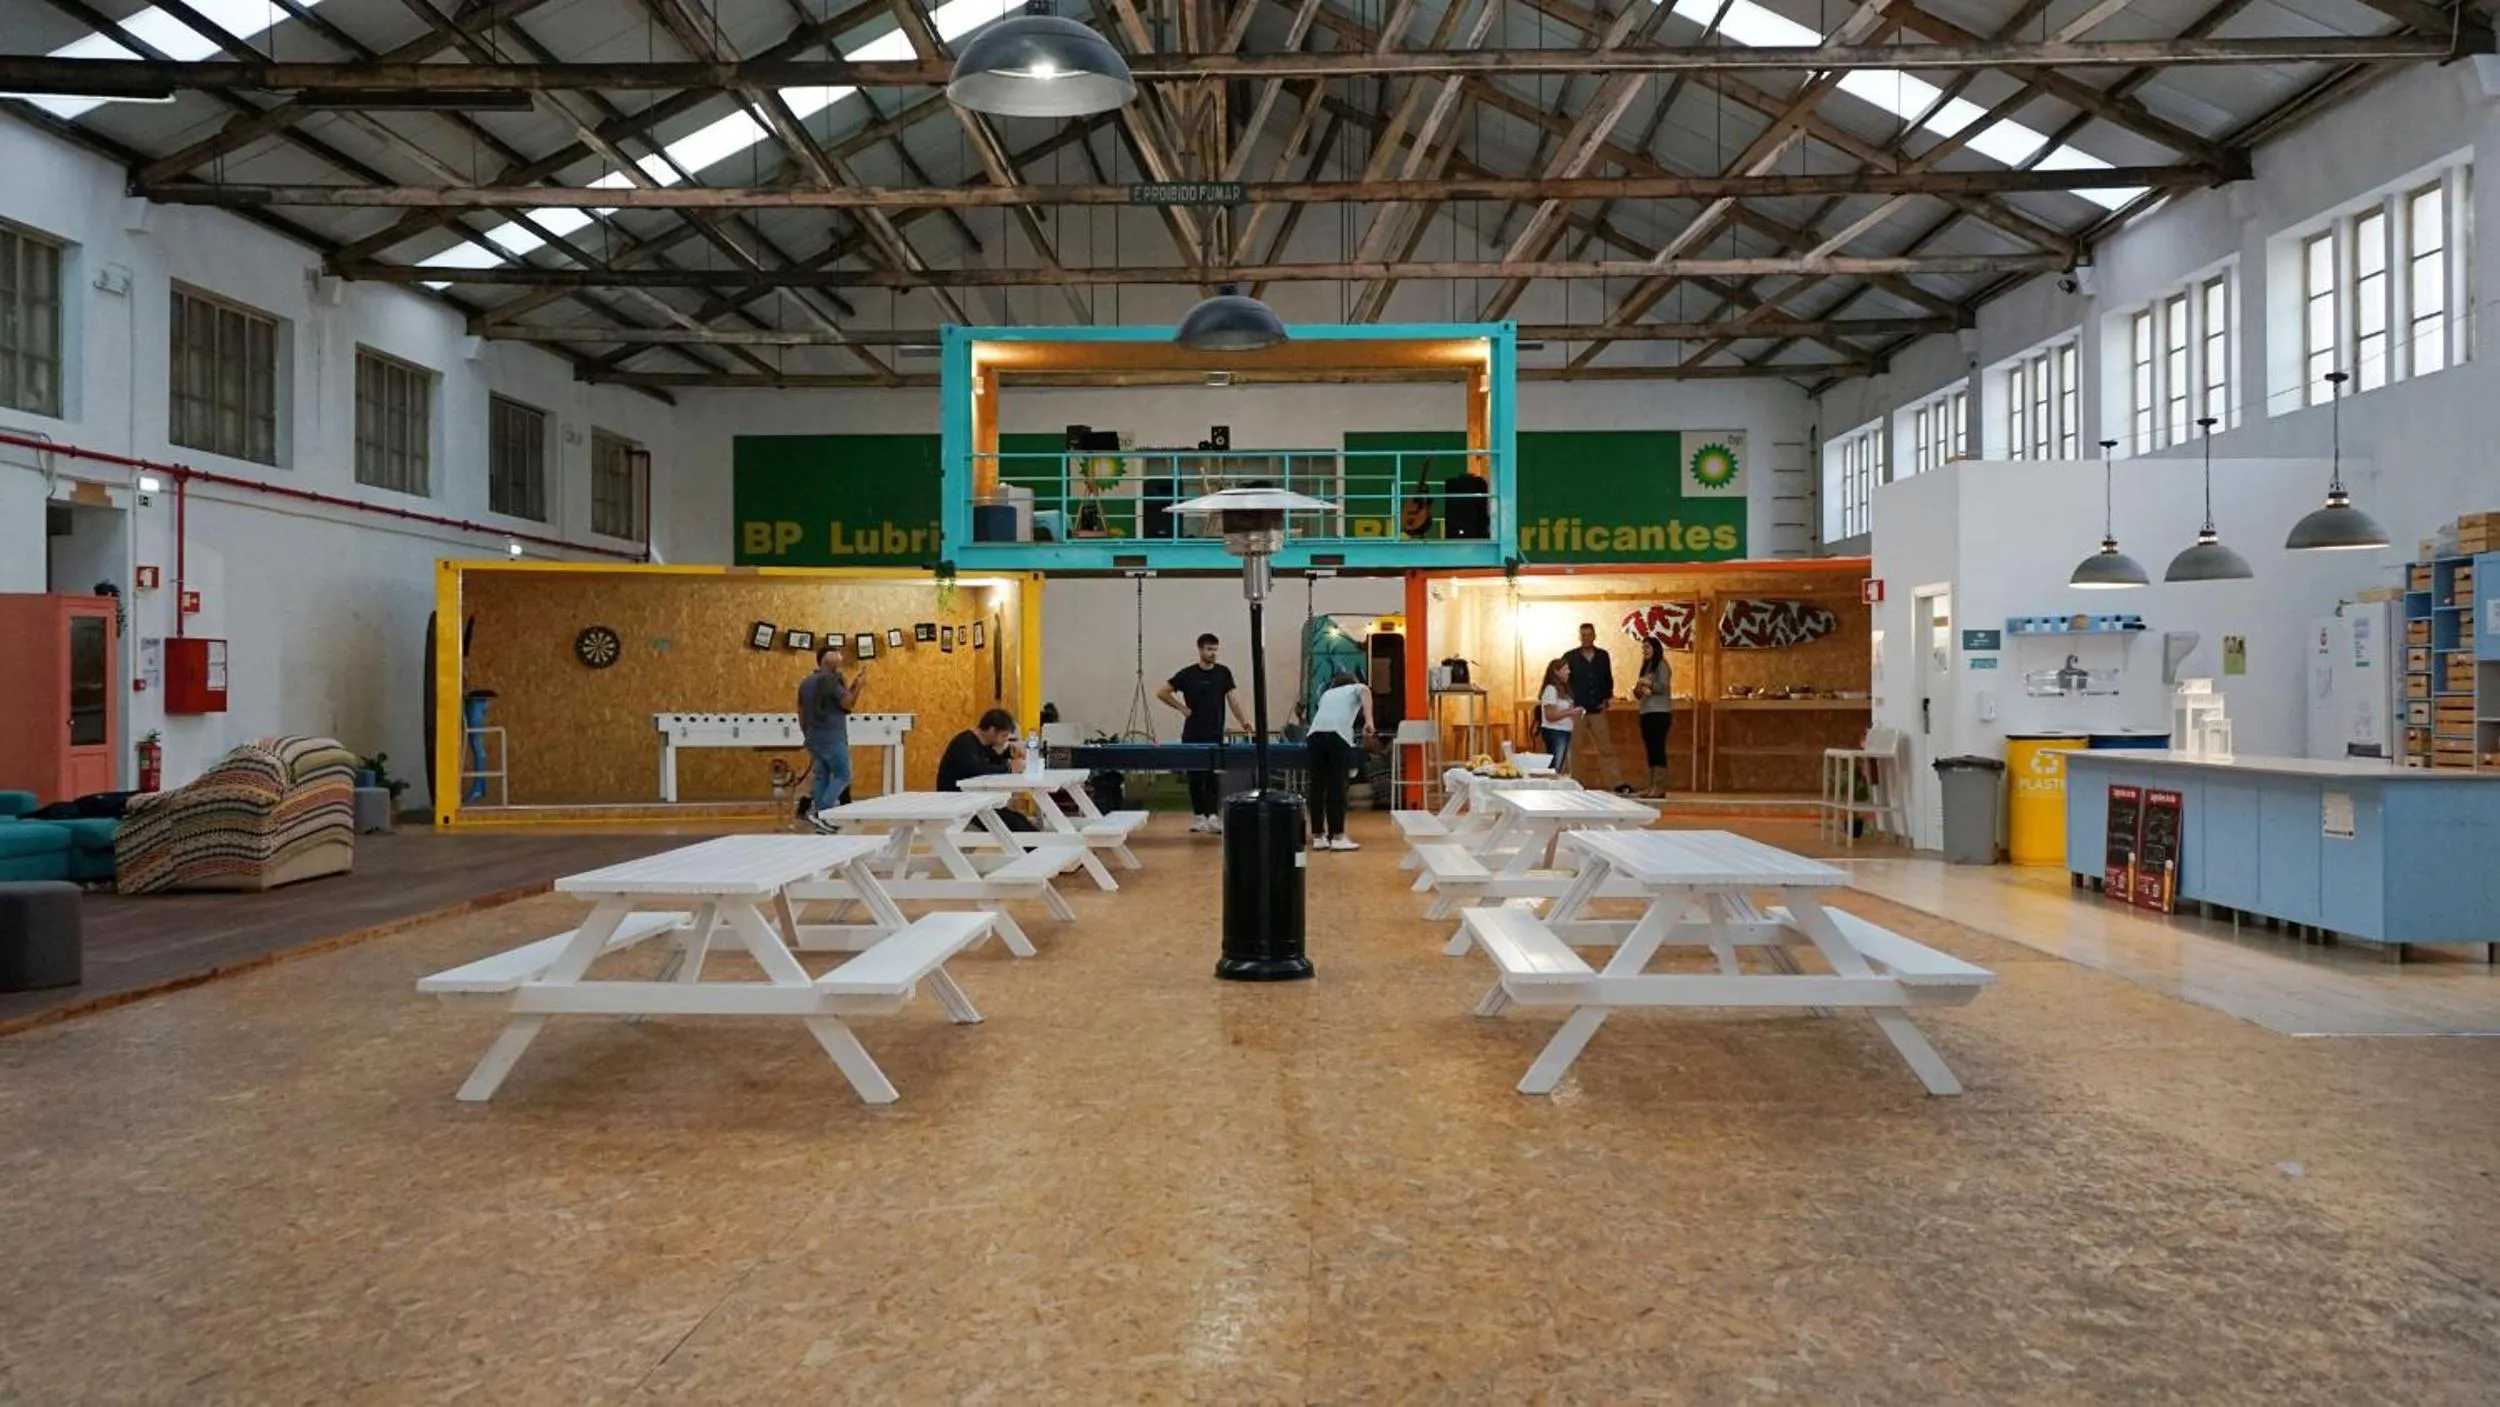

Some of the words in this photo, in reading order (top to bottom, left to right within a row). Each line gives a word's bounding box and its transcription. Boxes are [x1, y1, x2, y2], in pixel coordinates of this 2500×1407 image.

[1143, 186, 1197, 201] PROIBIDO
[1199, 185, 1241, 201] FUMAR
[744, 521, 803, 554] BP
[830, 521, 940, 554] Lubri
[1520, 517, 1738, 551] rificantes
